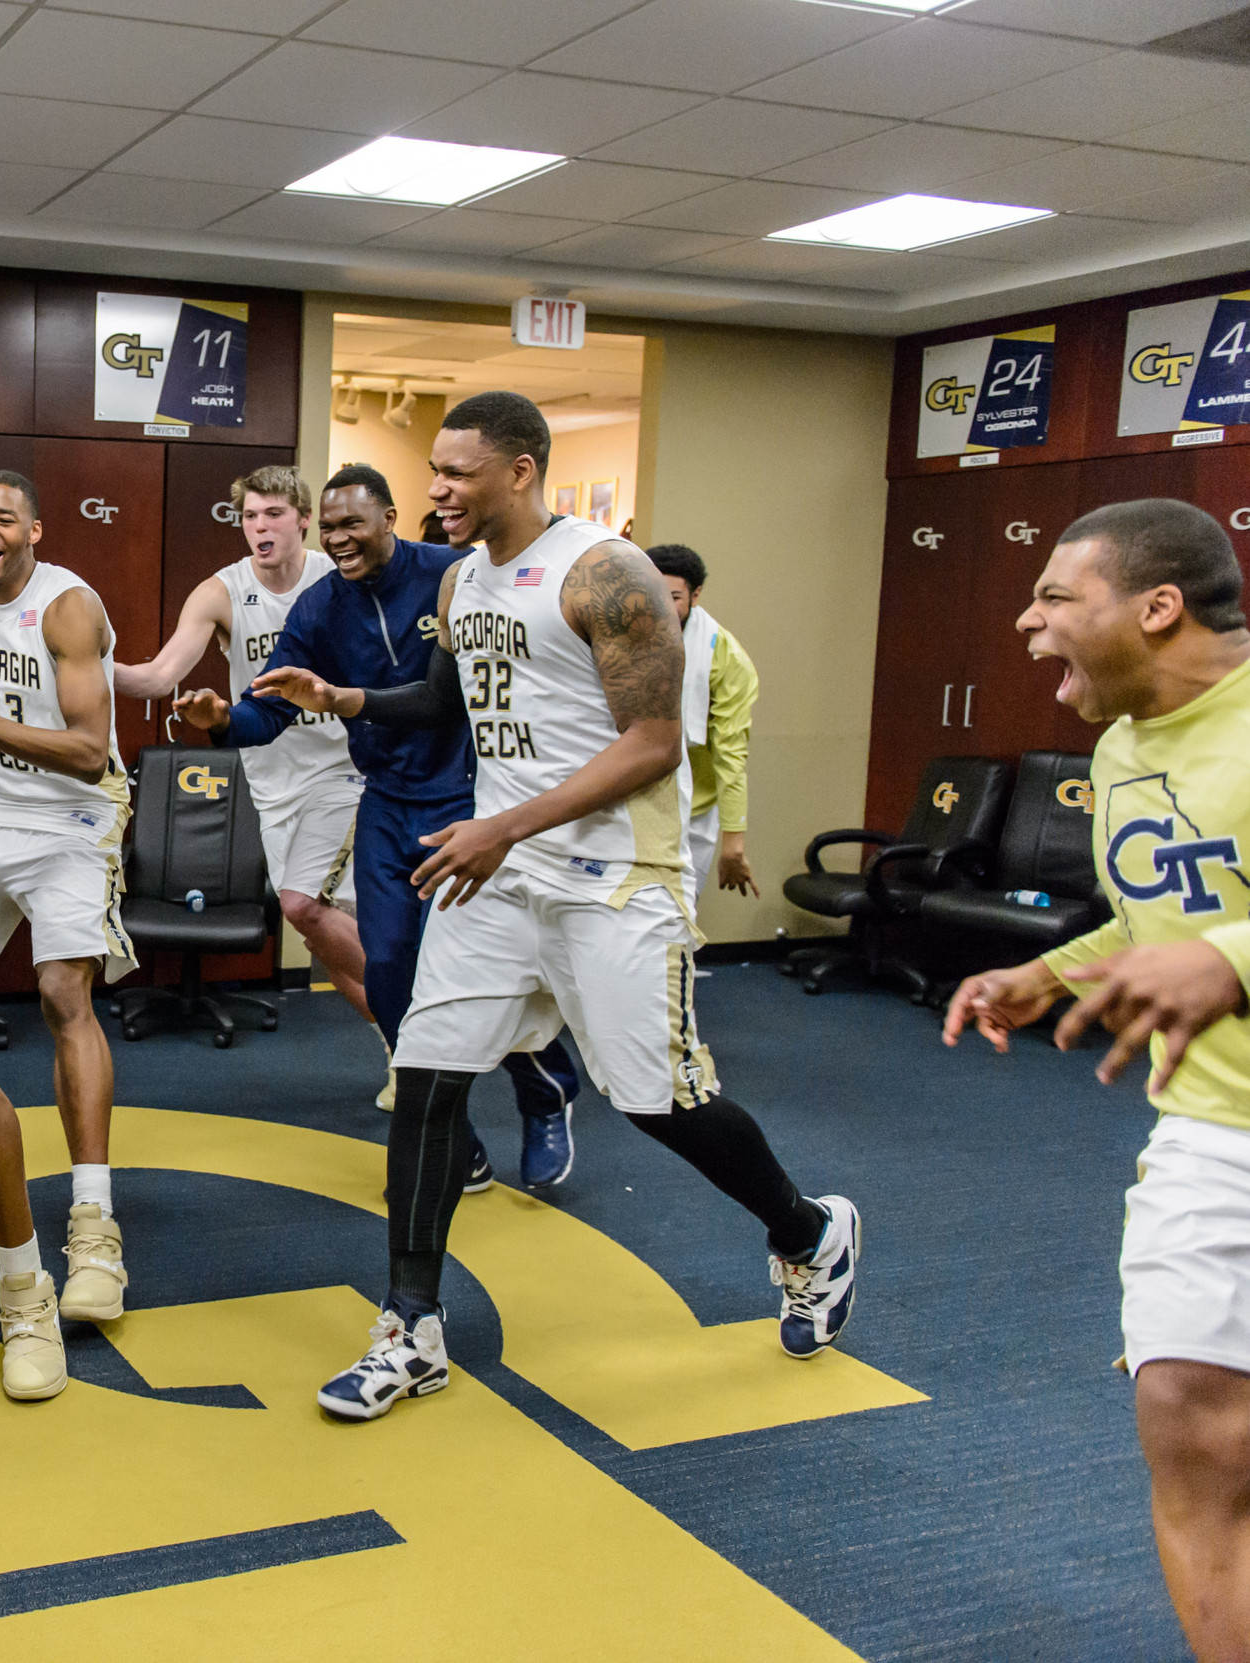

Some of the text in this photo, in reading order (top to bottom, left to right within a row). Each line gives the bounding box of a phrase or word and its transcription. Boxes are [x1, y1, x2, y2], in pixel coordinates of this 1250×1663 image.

[529, 299, 577, 345] EXIT
[102, 333, 163, 378] GT
[193, 329, 231, 368] 11
[1209, 321, 1250, 364] 4
[988, 353, 1042, 398] 24
[1128, 342, 1194, 388] GT
[191, 396, 234, 407] HEATH
[200, 384, 234, 394] JOSH
[925, 376, 976, 415] GT
[1198, 392, 1250, 408] LAMME
[147, 426, 186, 435] CONVICTION
[977, 406, 1038, 422] SYLVESTER
[1175, 431, 1221, 445] AGGRESSIVE
[79, 498, 119, 524] GT
[1230, 507, 1250, 531] G
[453, 611, 531, 660] GEORGIA
[469, 660, 512, 712] 32
[475, 720, 538, 759] ECH
[178, 766, 228, 800] GT
[1105, 815, 1242, 916] GT
